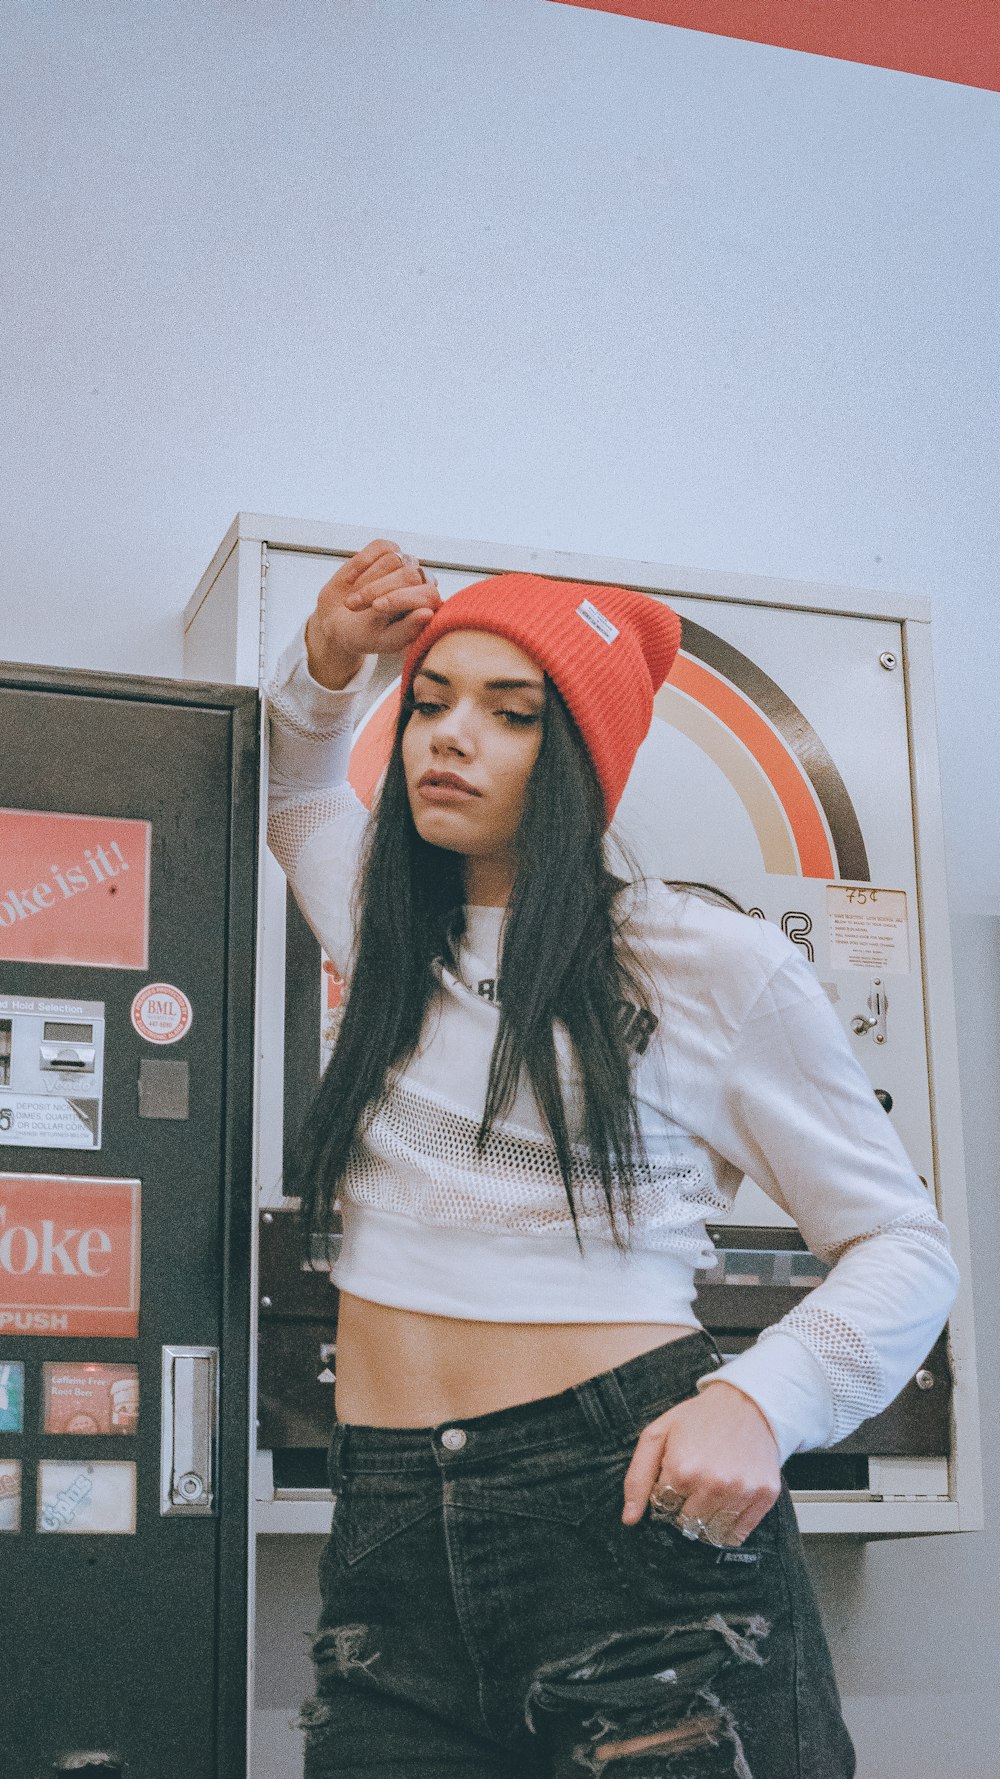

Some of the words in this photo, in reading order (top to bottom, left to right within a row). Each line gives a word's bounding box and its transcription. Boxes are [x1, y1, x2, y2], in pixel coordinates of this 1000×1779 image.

[49, 863, 89, 899] is
[82, 840, 129, 884] it!
[845, 888, 878, 905] 75¢
[12, 1001, 34, 1010] Hold
[38, 1002, 83, 1014] Selection
[148, 1000, 177, 1016] BML
[16, 1103, 51, 1111] DEPOSIT
[17, 1121, 30, 1129] OR
[31, 1122, 64, 1131] DOLLAR
[0, 1205, 112, 1278] oke
[0, 1311, 68, 1331] PUSH
